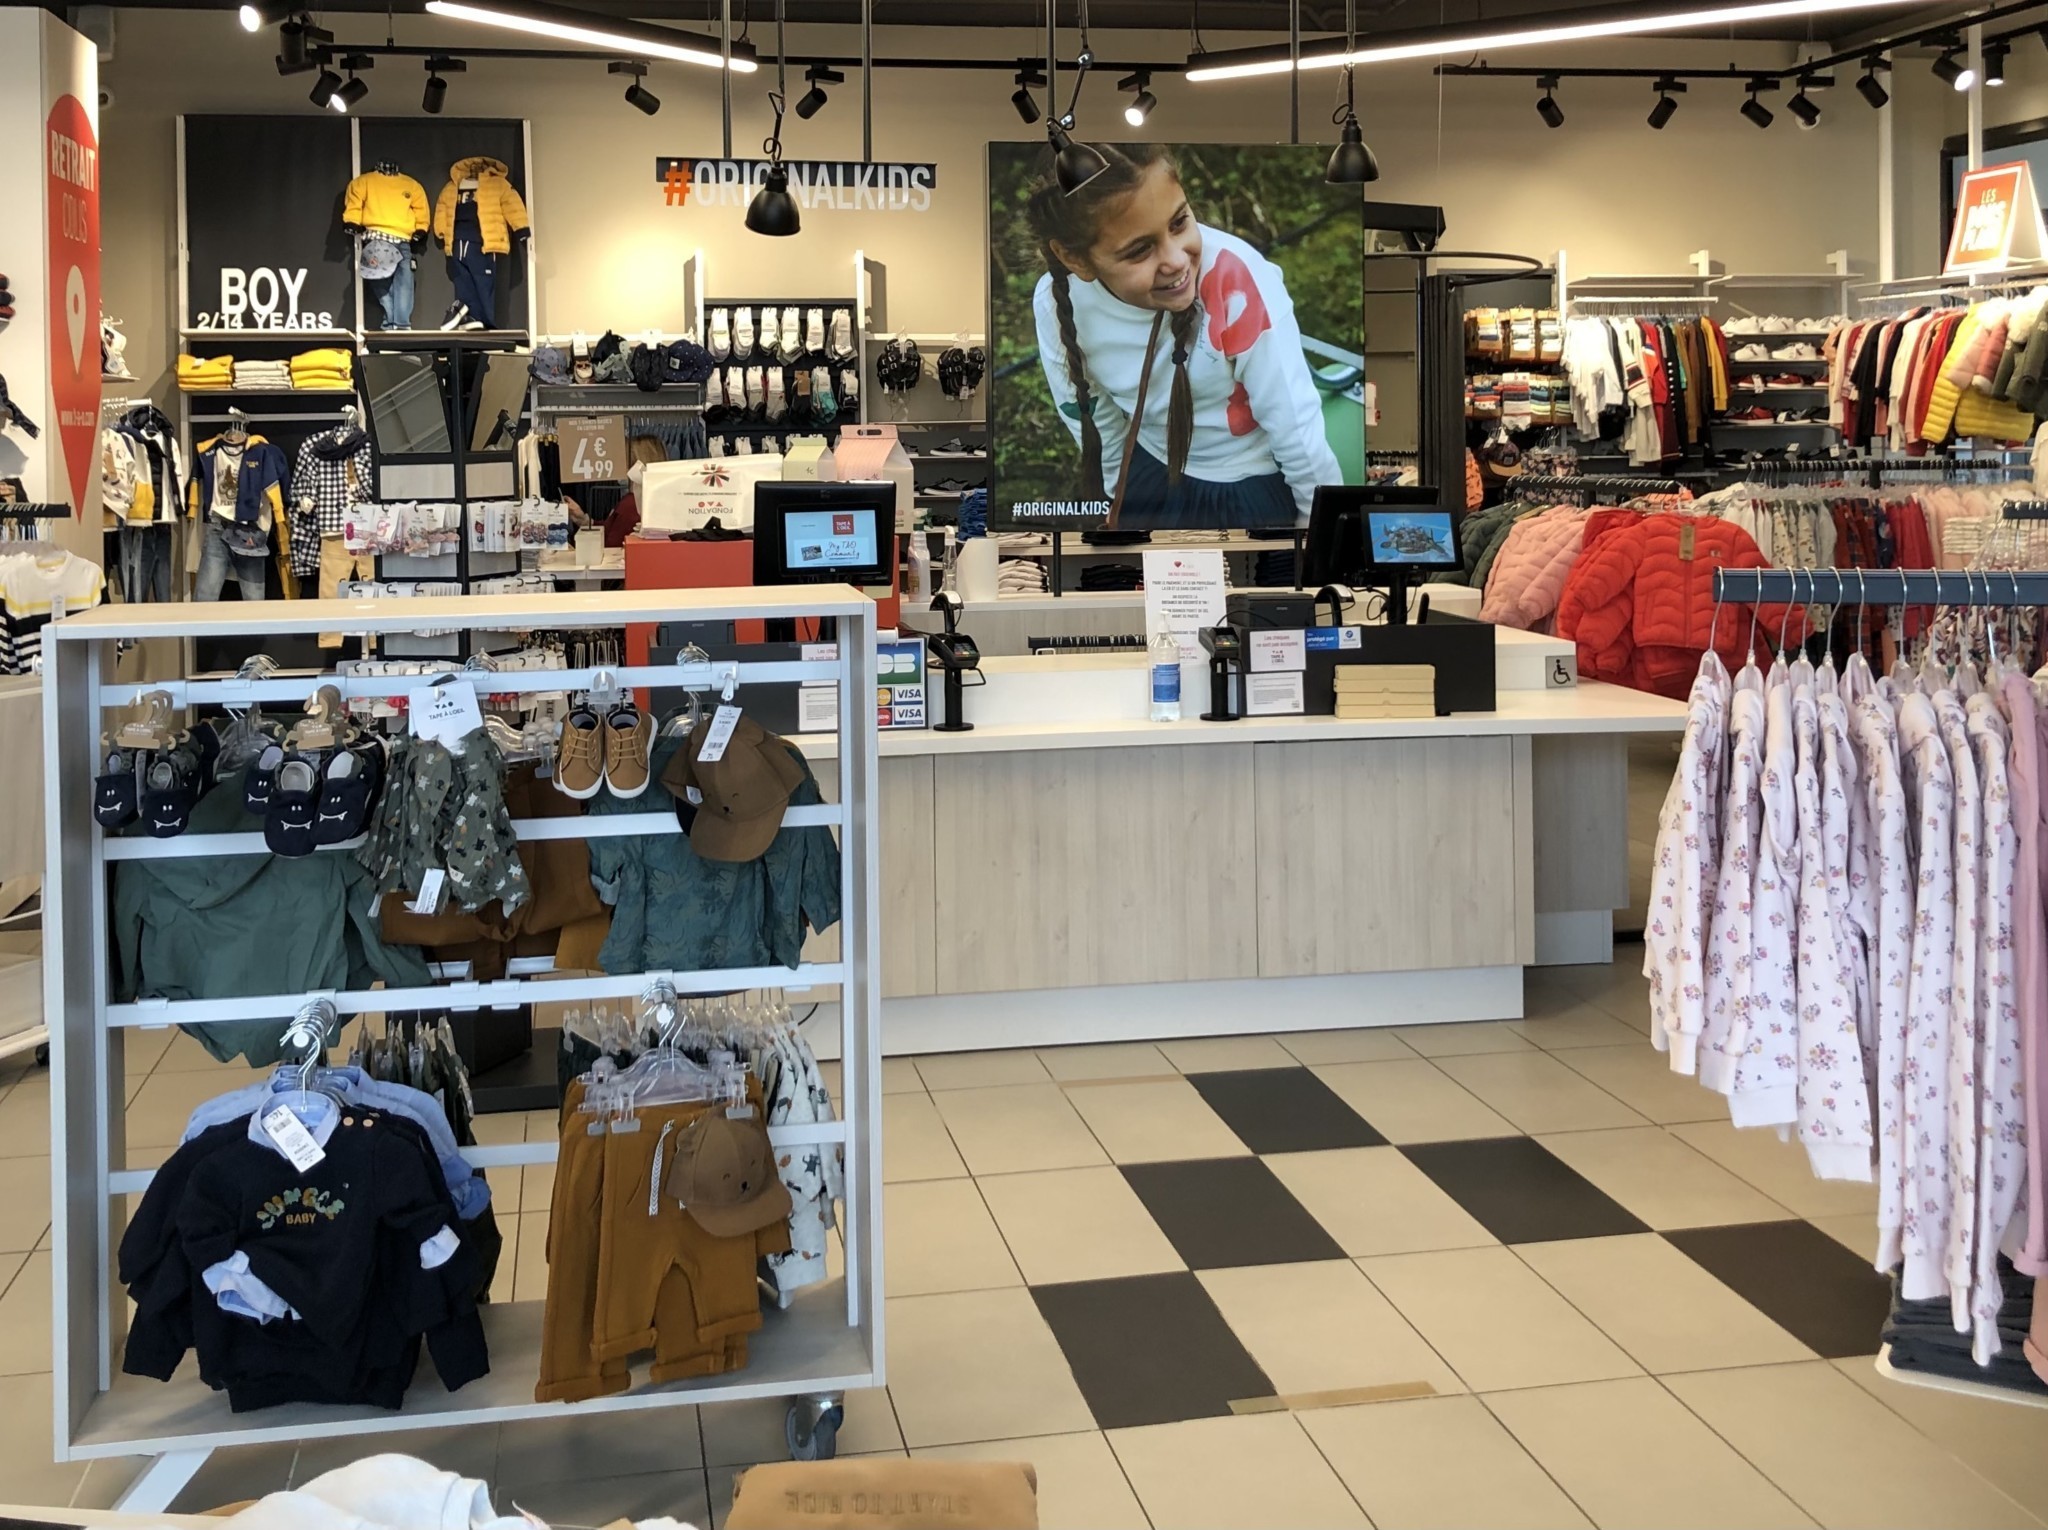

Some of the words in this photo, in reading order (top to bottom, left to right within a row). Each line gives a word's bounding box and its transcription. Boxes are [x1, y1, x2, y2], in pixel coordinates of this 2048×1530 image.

[51, 130, 95, 192] RETRAIT
[1980, 188, 1997, 204] LES
[221, 267, 308, 315] BOY
[197, 312, 243, 329] 2/14
[252, 311, 333, 329] YEARS
[593, 437, 607, 457] €
[572, 438, 594, 479] 4
[594, 459, 613, 478] 99
[688, 507, 733, 515] FONDATION
[1012, 501, 1110, 516] #ORIGINALKIDS
[897, 689, 922, 698] VISA
[898, 708, 922, 718] VISA
[285, 1212, 316, 1225] BABY
